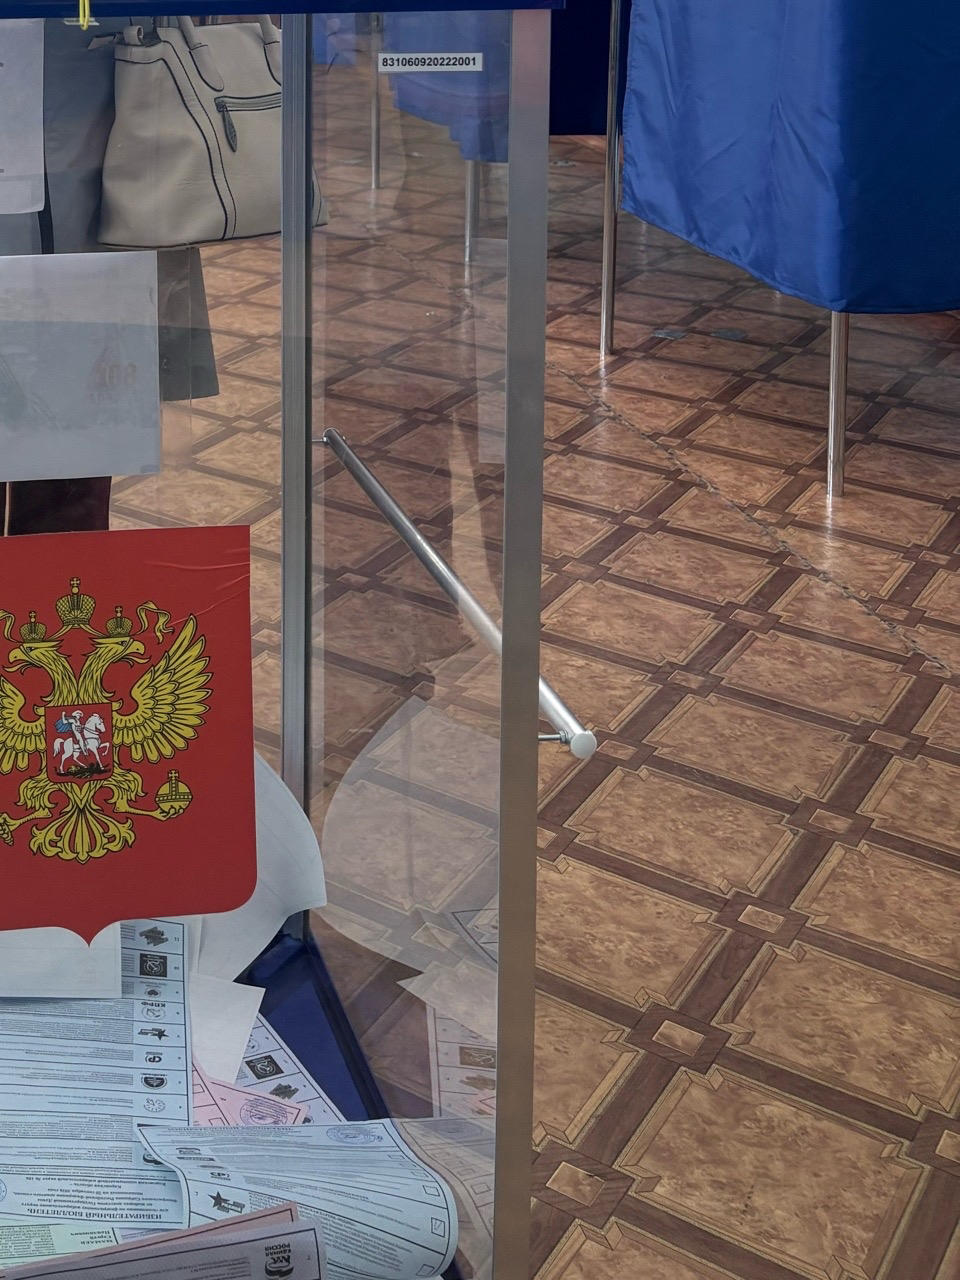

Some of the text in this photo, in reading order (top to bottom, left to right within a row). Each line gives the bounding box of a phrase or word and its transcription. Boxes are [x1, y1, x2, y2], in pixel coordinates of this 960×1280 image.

[382, 56, 476, 67] 831060920222001
[27, 1208, 162, 1220] ИЗБИРАТЕЛЬНЫЙ БЮЛЛЕТЕНЬ
[265, 1243, 291, 1251] РОССИЯ
[265, 1249, 292, 1257] ЕДИНАЯ
